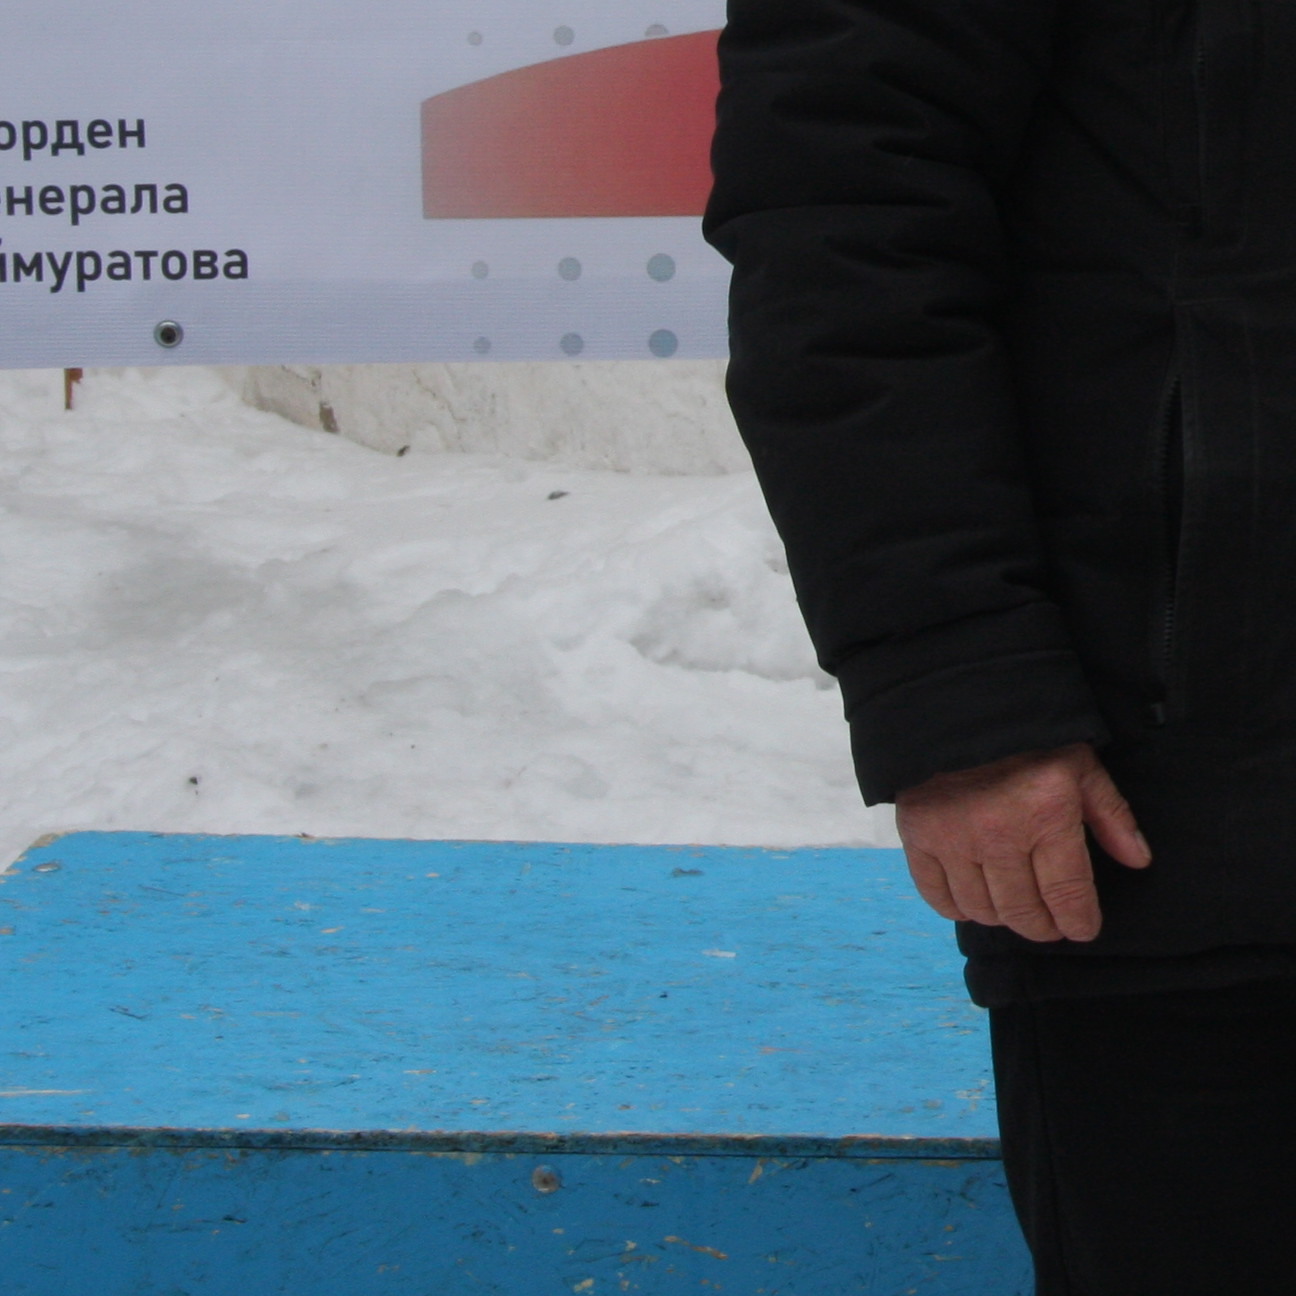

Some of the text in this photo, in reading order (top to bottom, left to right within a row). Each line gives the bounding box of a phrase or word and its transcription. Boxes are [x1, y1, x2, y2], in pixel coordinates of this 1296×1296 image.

[0, 119, 146, 160] орден
[0, 184, 188, 226] нерала
[0, 237, 249, 293] муратова
